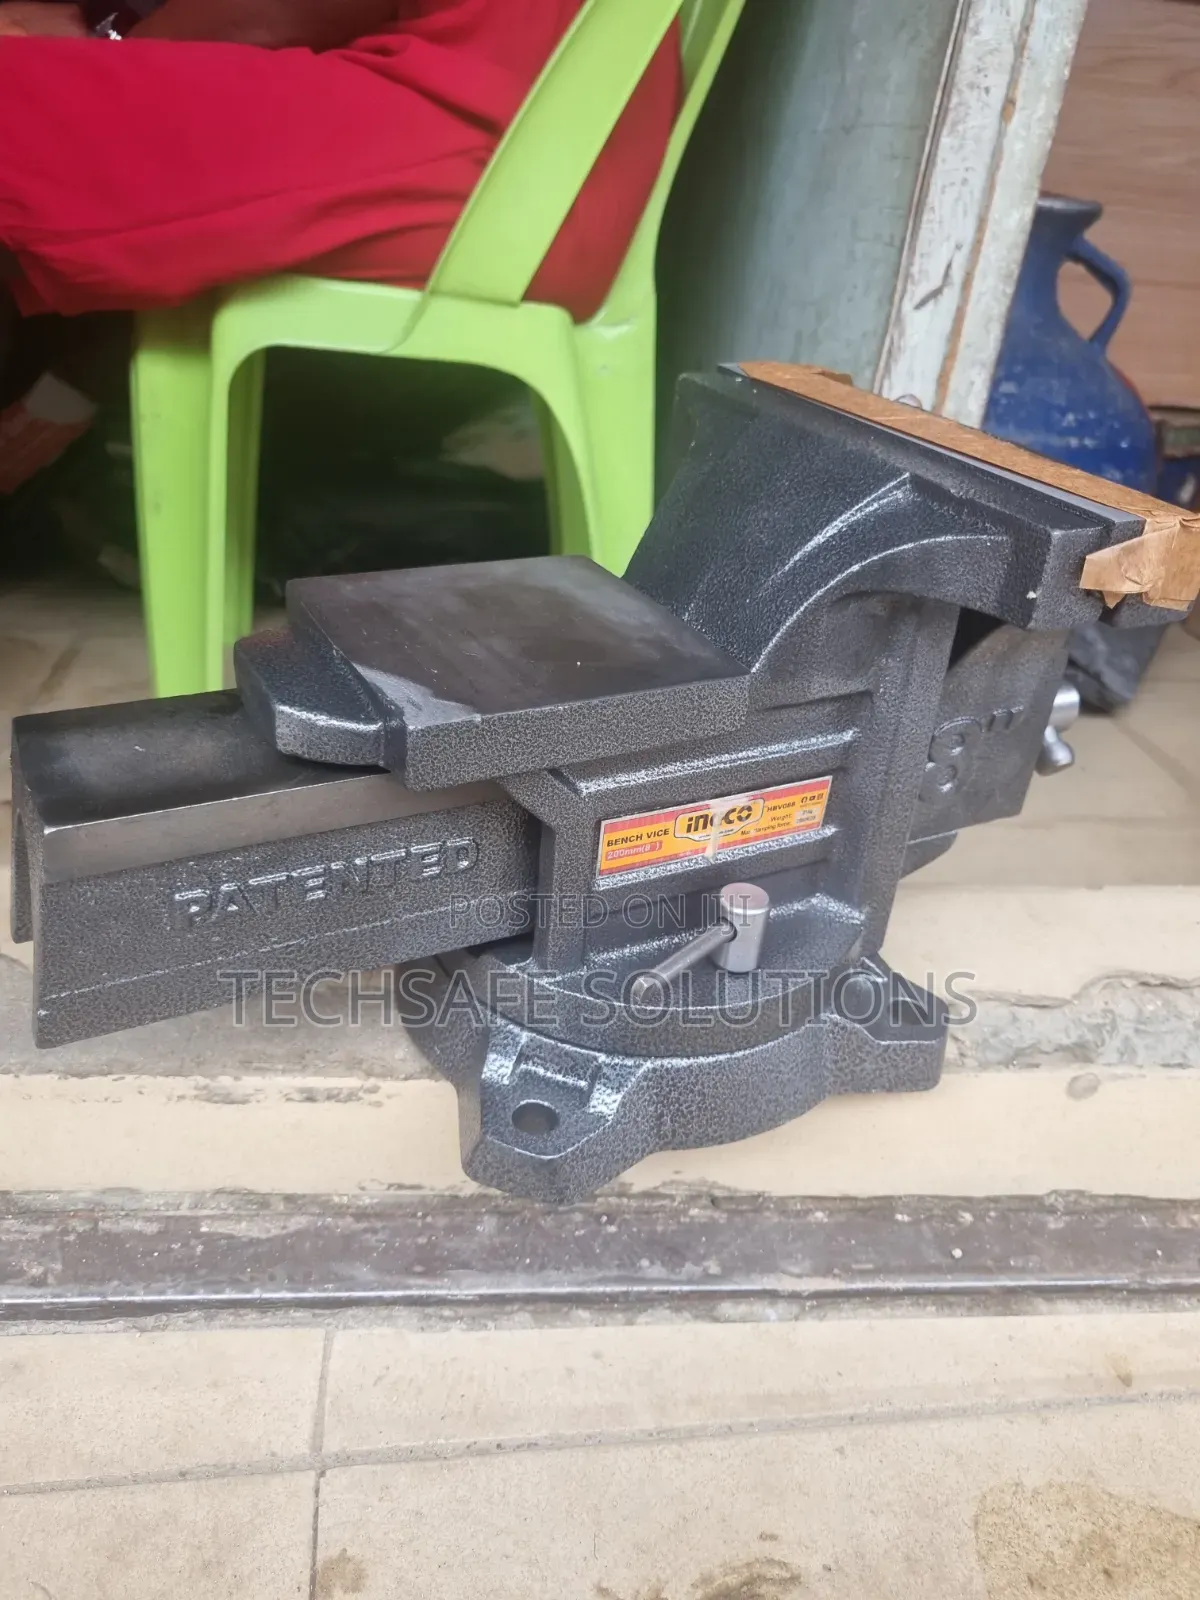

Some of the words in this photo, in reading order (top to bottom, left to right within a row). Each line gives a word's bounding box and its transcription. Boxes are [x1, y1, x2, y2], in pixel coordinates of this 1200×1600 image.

[686, 803, 753, 833] inco
[607, 834, 643, 847] BENCH
[646, 828, 670, 839] VICE
[607, 841, 660, 860] 200mm(8)
[174, 836, 480, 927] PATENTED
